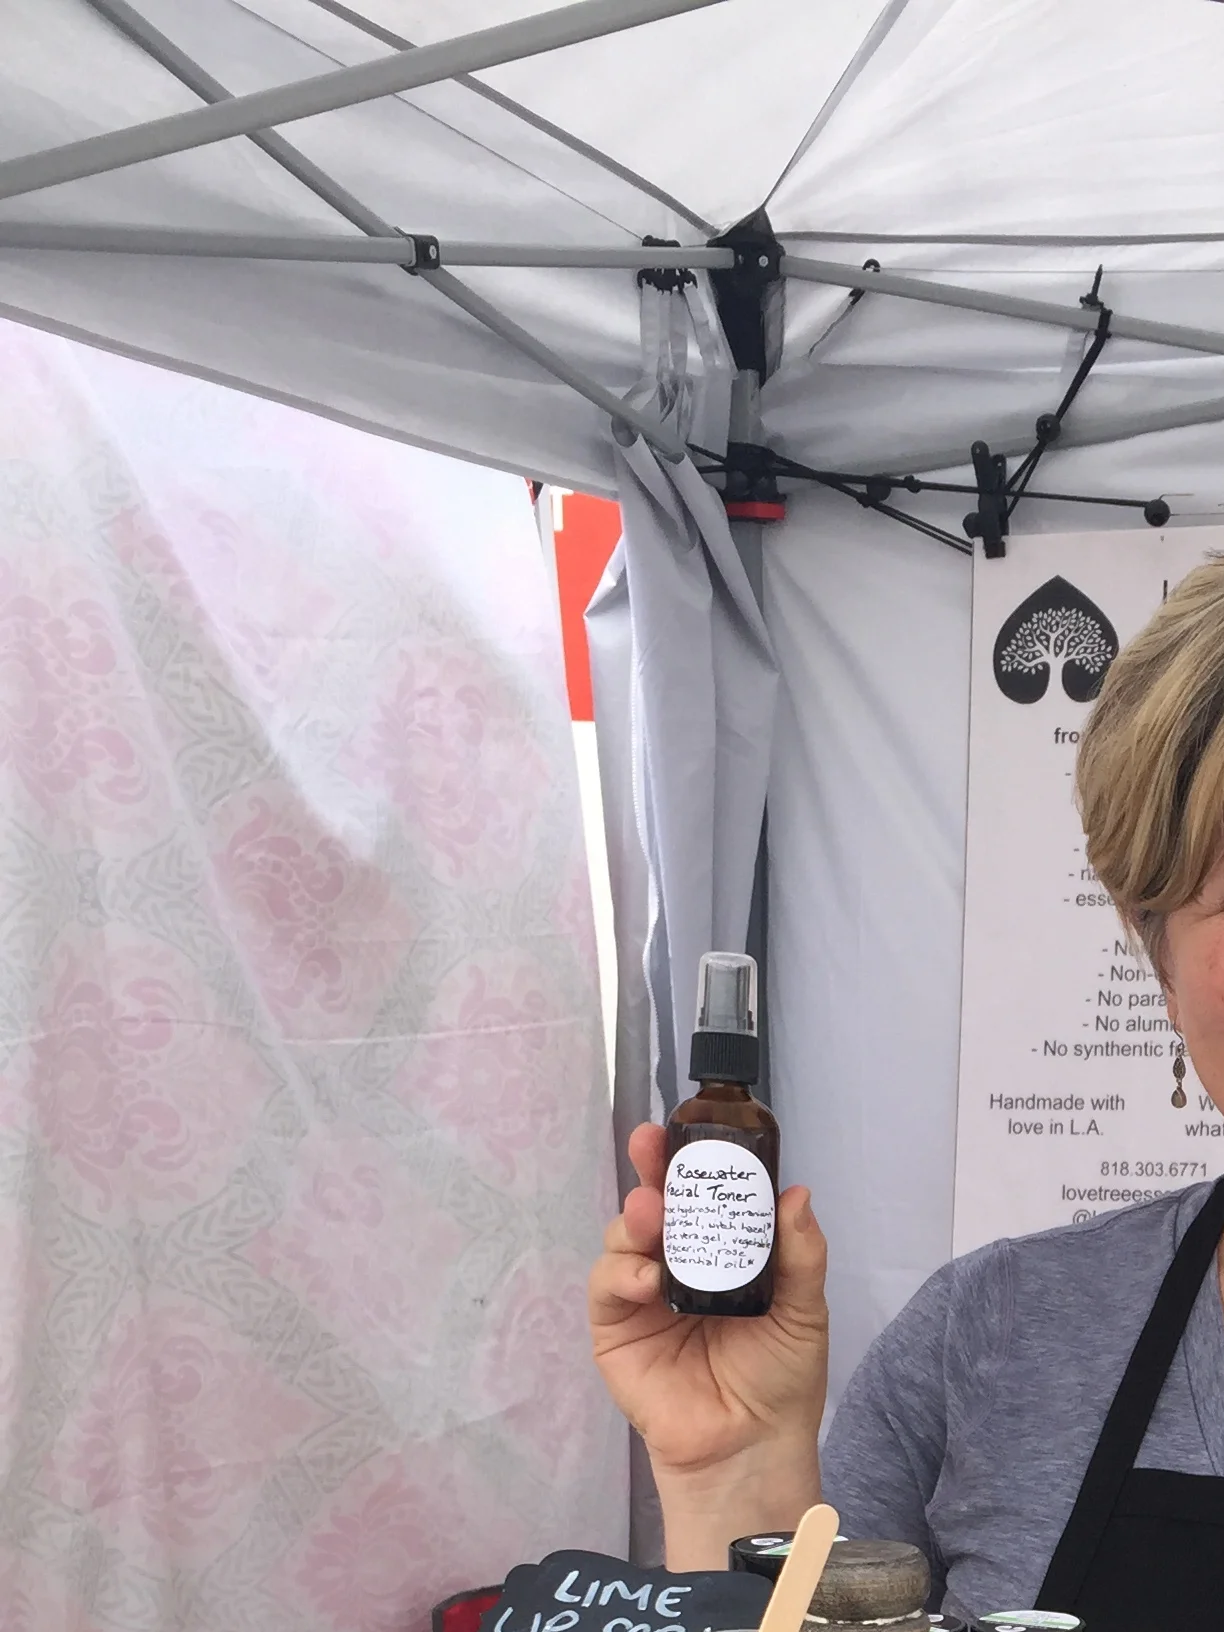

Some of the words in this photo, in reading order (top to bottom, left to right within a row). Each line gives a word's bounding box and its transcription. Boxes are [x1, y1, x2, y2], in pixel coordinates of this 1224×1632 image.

[1098, 990, 1122, 1006] No
[1095, 1015, 1120, 1032] No
[1043, 1040, 1068, 1057] No
[1074, 1040, 1163, 1060] synthentic
[990, 1093, 1084, 1111] Handmade
[1091, 1094, 1125, 1111] with
[1008, 1119, 1043, 1135] love
[1050, 1120, 1064, 1135] in
[1070, 1120, 1104, 1135] L.A.
[677, 1164, 757, 1180] Rosewater
[1100, 1161, 1208, 1177] 818.303.6771
[707, 1184, 757, 1202] Toner
[554, 1570, 692, 1618] LIME
